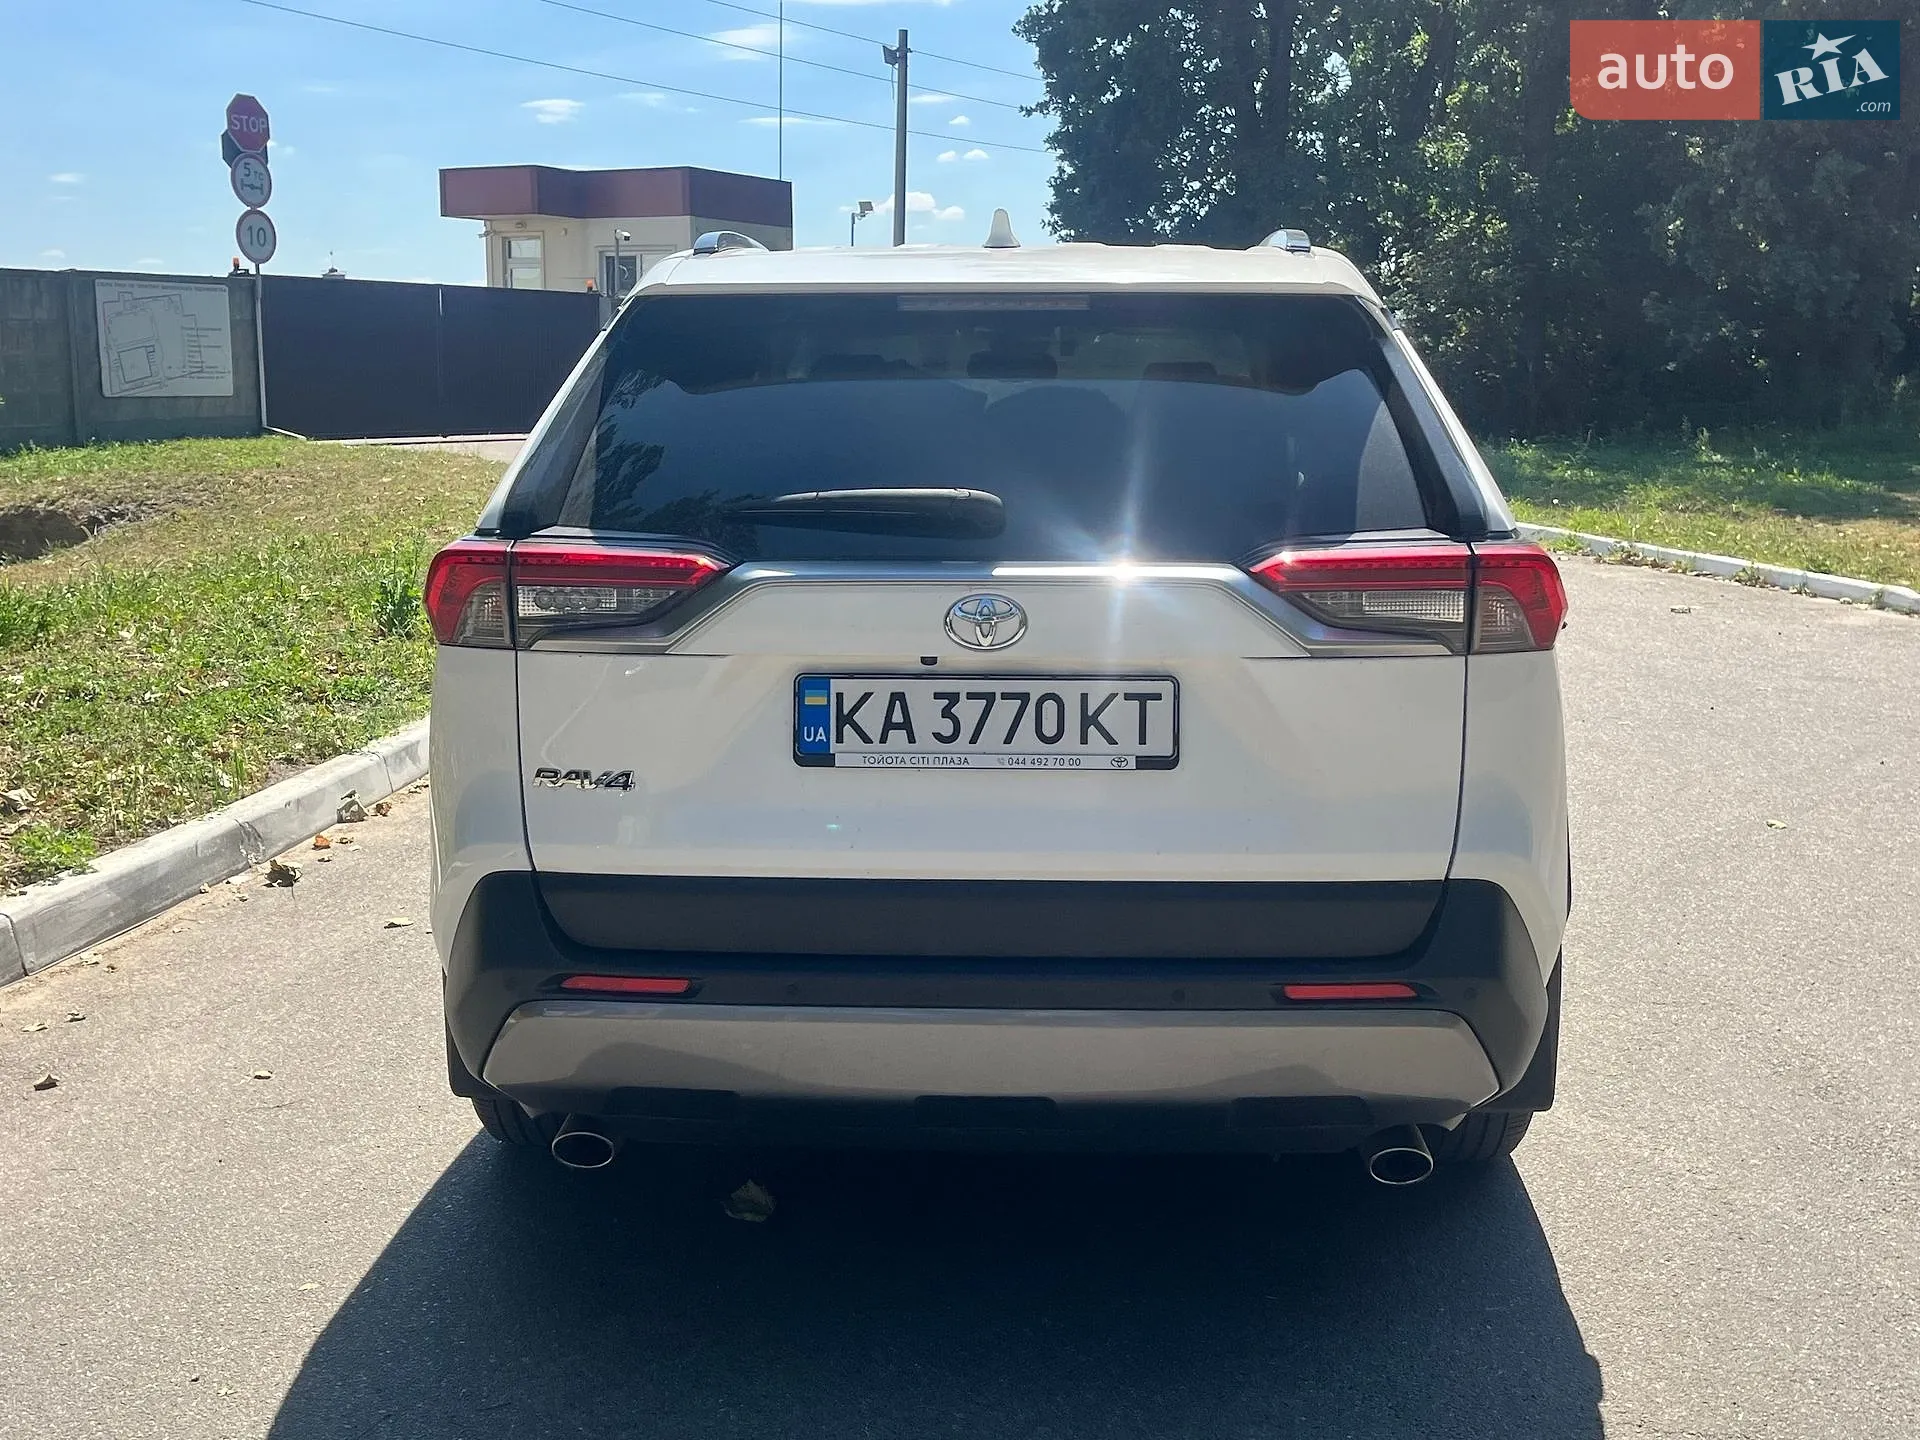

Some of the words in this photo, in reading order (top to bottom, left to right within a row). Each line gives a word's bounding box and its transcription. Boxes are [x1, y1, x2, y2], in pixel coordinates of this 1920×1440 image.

[231, 114, 268, 133] STOP
[243, 162, 251, 177] 5
[247, 225, 267, 247] 10
[835, 691, 916, 745] KA
[931, 691, 1065, 745] 3770
[1079, 692, 1163, 746] KT
[804, 725, 827, 743] UA
[862, 754, 907, 767] ТОЙОТА
[932, 755, 970, 766] ПЛАЗА
[1007, 757, 1026, 767] 044
[1030, 757, 1049, 767] 492
[1052, 757, 1065, 767] 70
[1068, 757, 1081, 767] 00
[533, 767, 636, 792] RAV4
